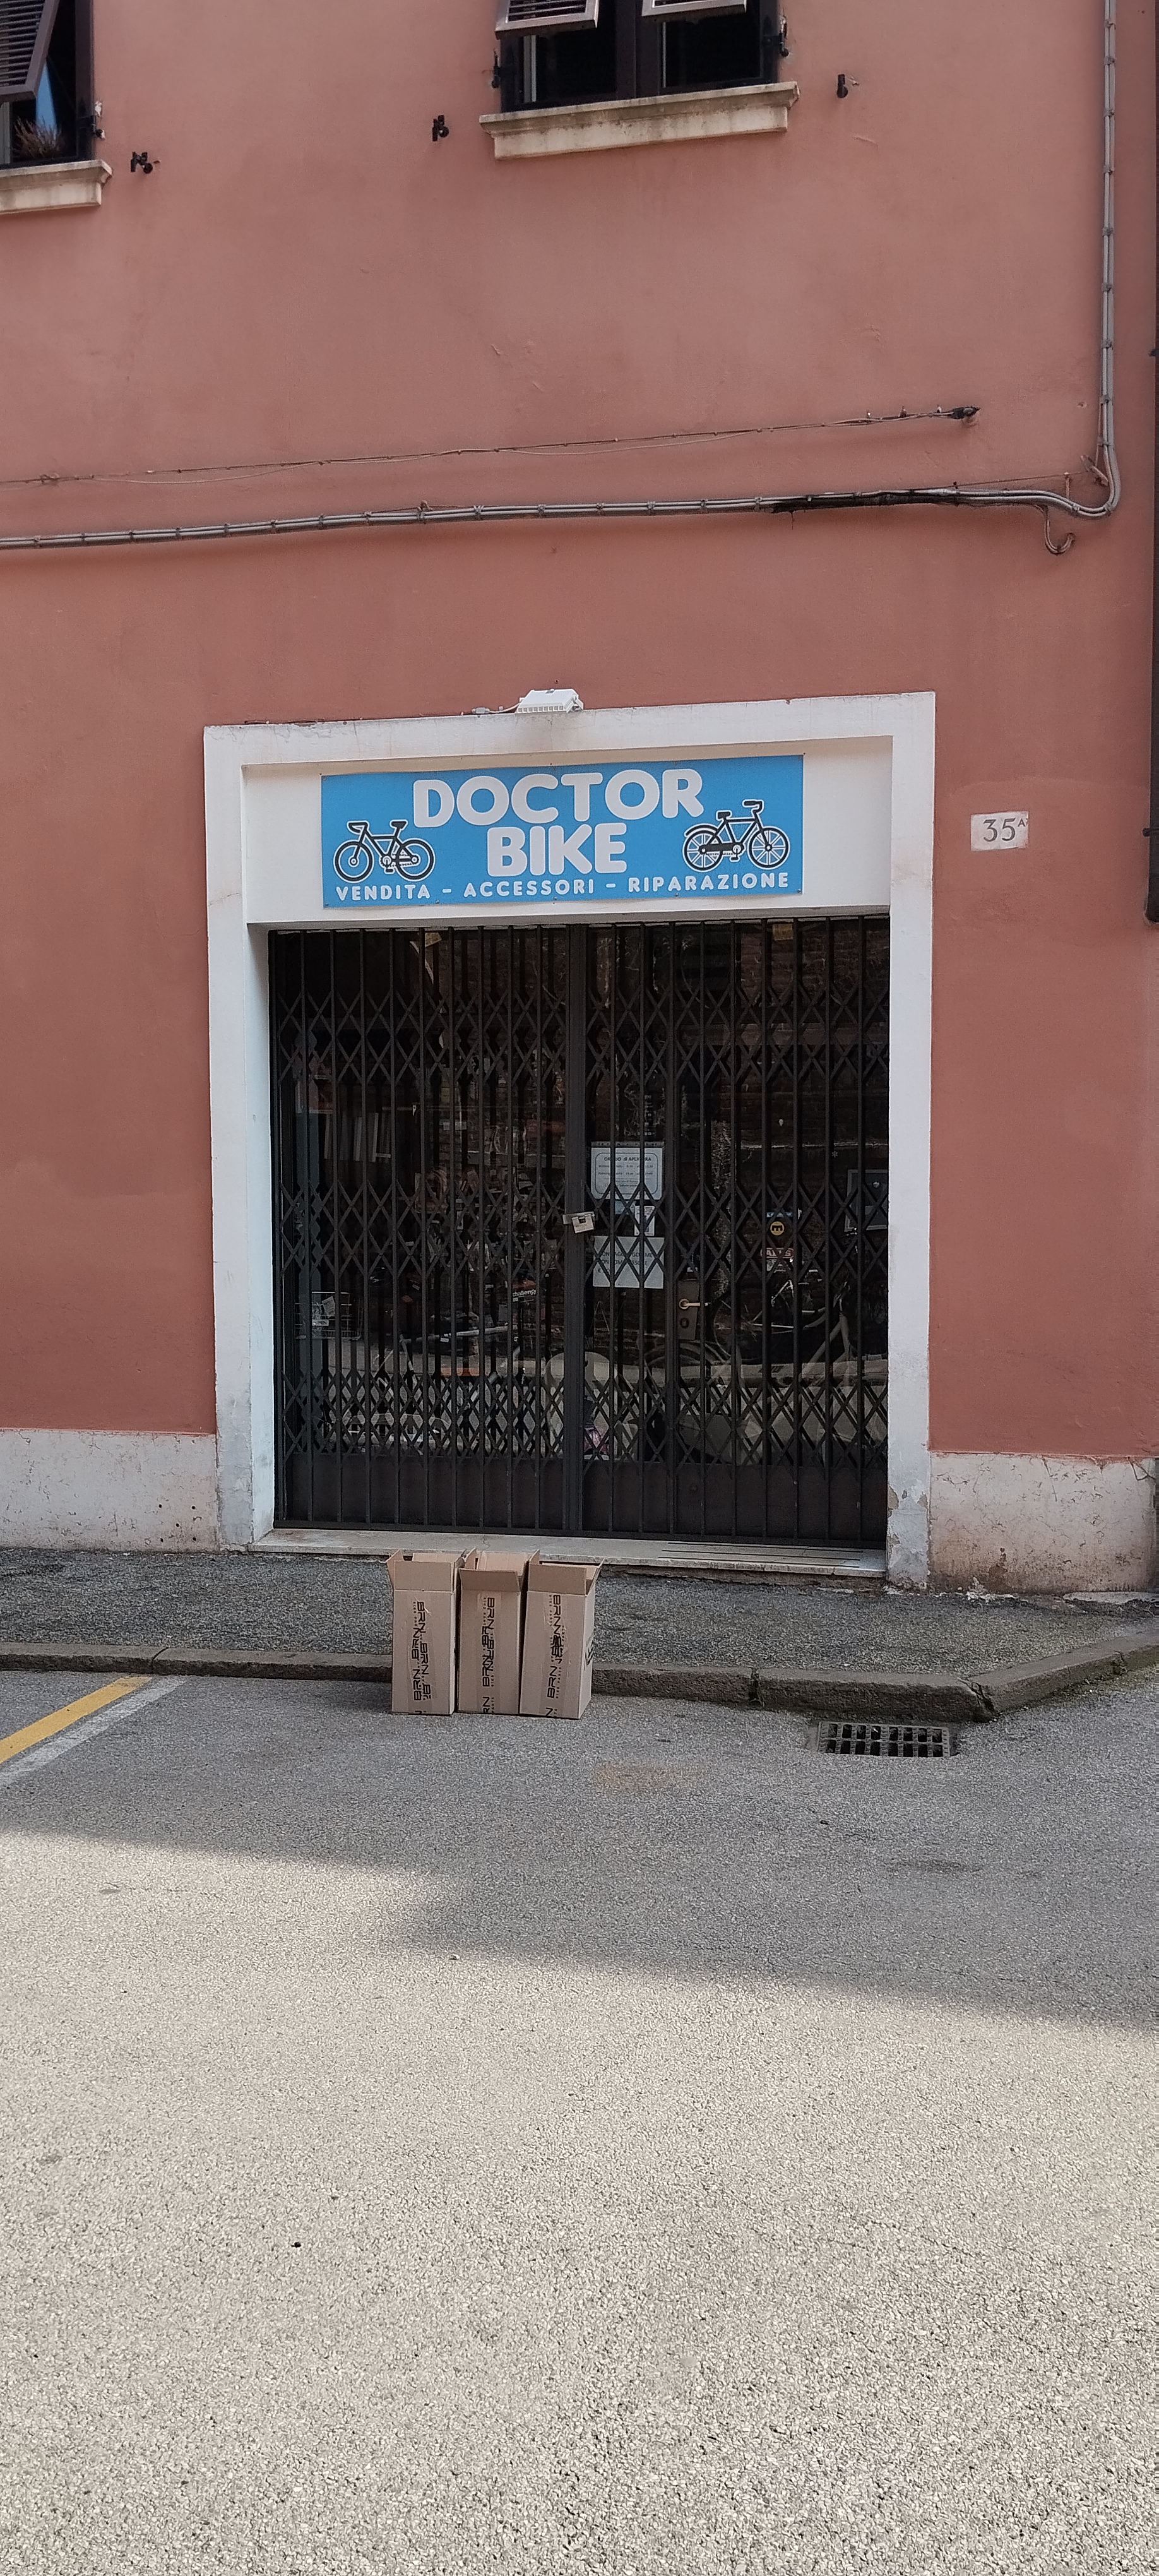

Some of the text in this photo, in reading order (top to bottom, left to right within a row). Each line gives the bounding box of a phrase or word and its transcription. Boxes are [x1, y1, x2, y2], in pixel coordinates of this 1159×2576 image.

[412, 768, 704, 828] DOCTOR
[486, 822, 627, 877] BIKE
[335, 884, 431, 901] VENDITA
[463, 879, 594, 897] ACCESSORI
[628, 872, 788, 892] RIPARAZIONE
[547, 1666, 558, 1698] BRN
